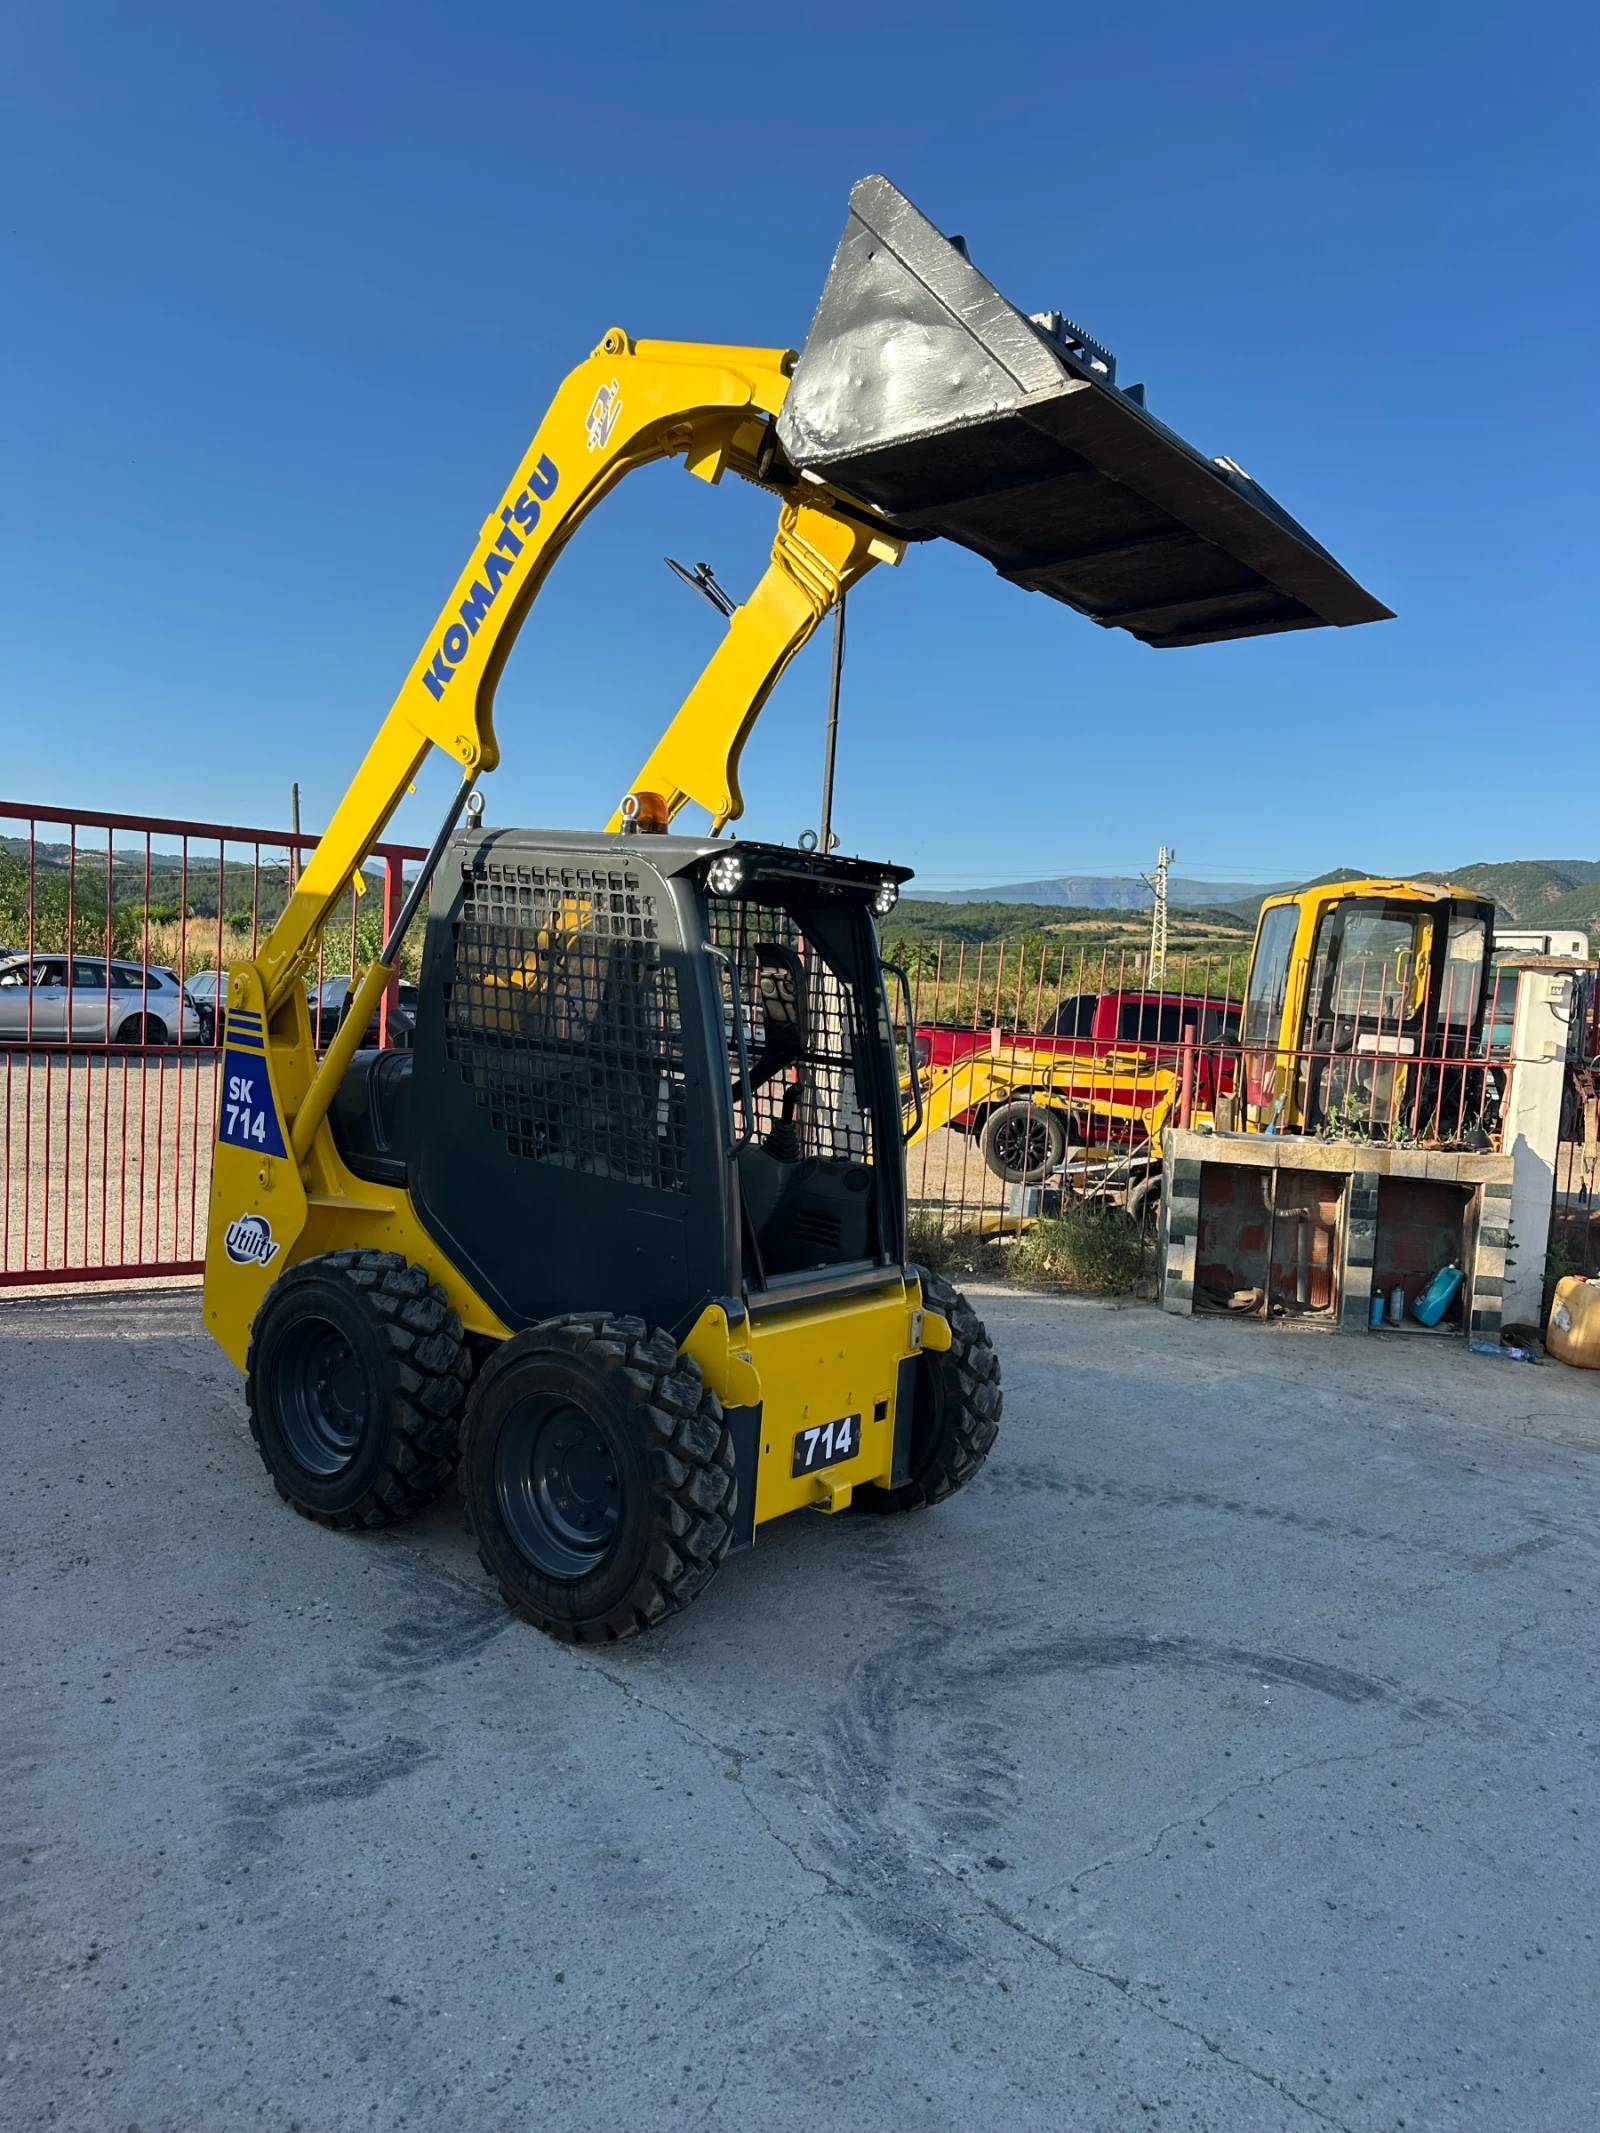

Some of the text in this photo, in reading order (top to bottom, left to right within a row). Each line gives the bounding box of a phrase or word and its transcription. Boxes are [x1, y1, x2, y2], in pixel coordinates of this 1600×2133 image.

[421, 452, 560, 703] KOMATSU
[228, 1075, 254, 1104] SK
[226, 1104, 266, 1143] 714
[225, 1225, 278, 1265] Utility
[803, 1417, 853, 1467] 714
